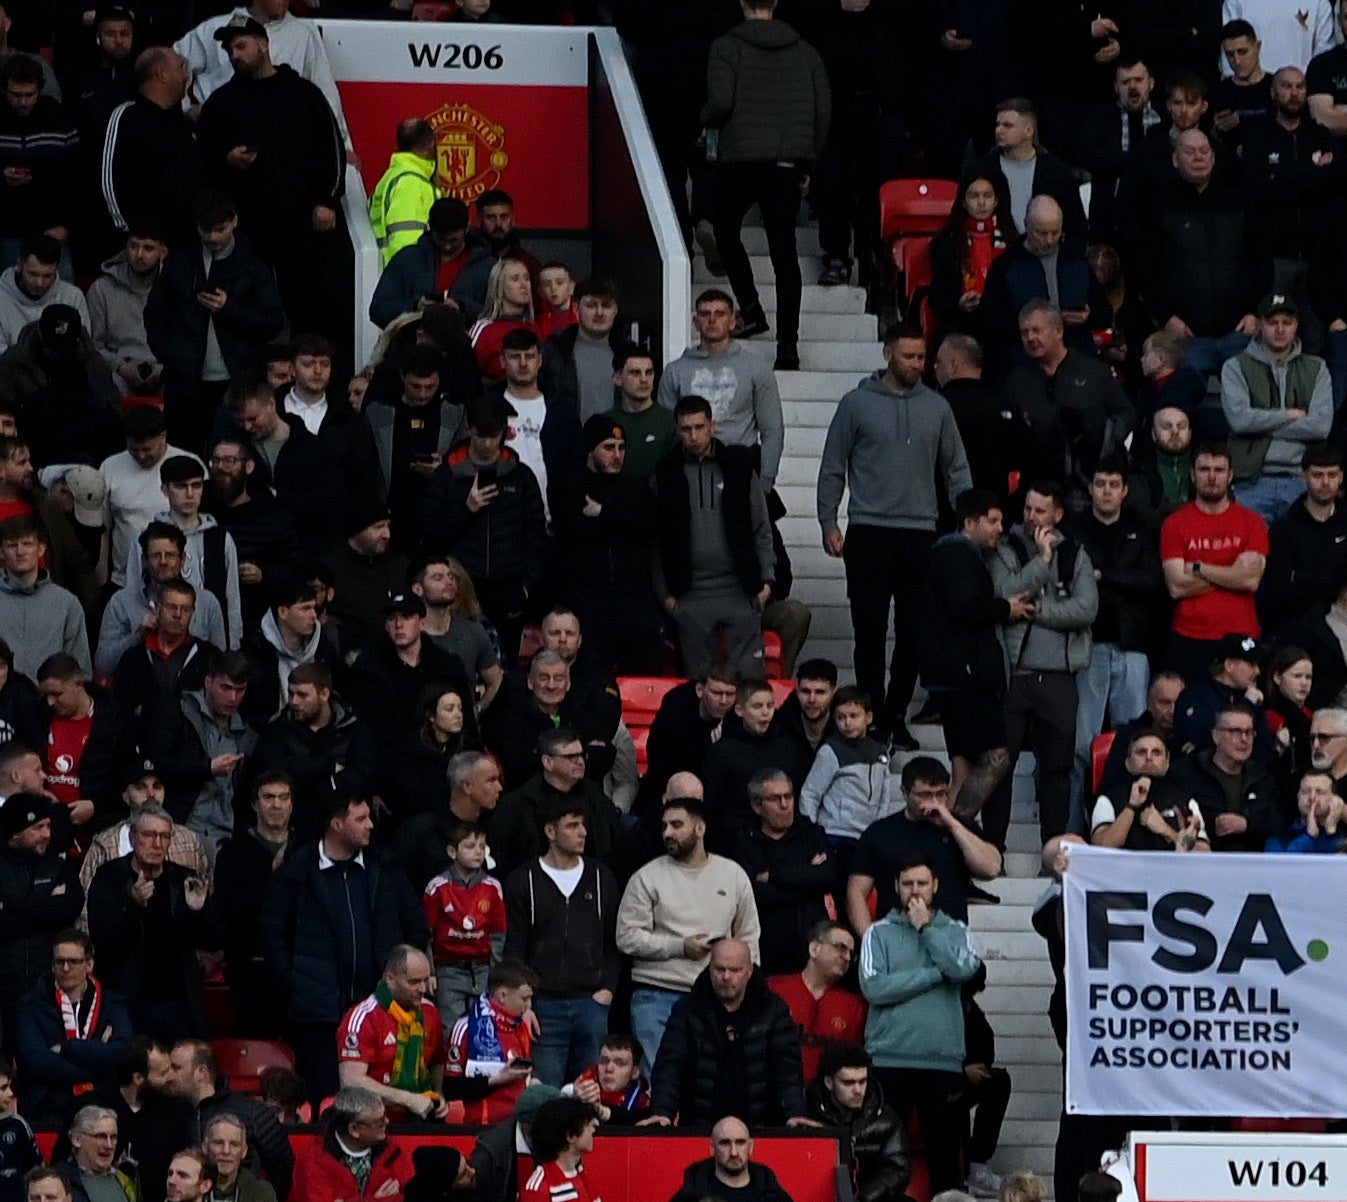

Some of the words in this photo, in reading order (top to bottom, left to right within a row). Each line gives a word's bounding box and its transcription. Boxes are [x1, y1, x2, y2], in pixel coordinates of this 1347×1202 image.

[407, 42, 504, 70] W206
[1089, 983, 1291, 1016] FOOTBALL
[1089, 1045, 1291, 1071] ASSOCIATION
[1228, 1160, 1329, 1187] W104
